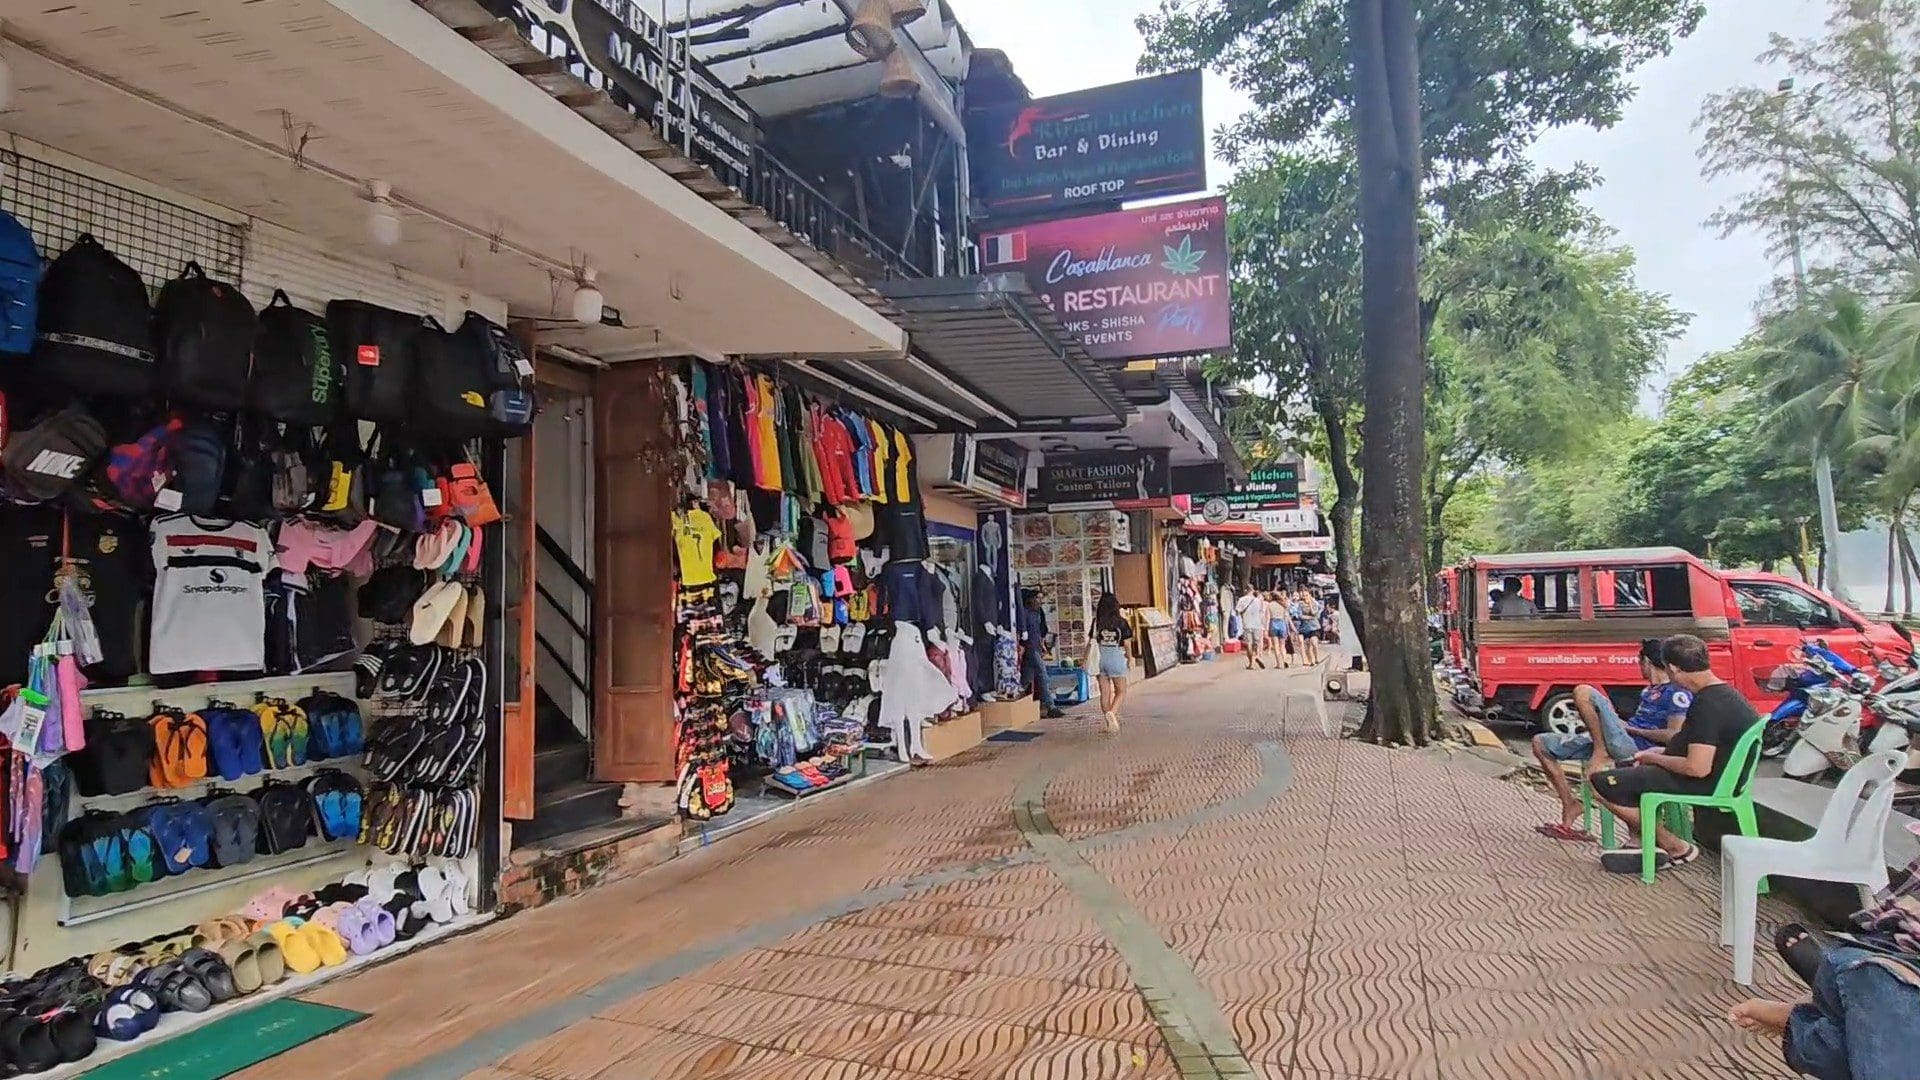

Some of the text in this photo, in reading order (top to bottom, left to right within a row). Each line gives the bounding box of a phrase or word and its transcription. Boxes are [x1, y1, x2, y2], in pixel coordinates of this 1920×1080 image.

[608, 31, 701, 121] MARLIN
[1035, 130, 1159, 160] Bar & Dining
[1064, 179, 1125, 199] ROOF TOP
[1046, 245, 1154, 284] Casablanca
[1064, 275, 1220, 313] RESTAURANT
[1101, 315, 1146, 330] SHISHA
[1085, 331, 1133, 345] EVENTS
[309, 322, 332, 404] Superdry
[26, 449, 86, 480] NIKE
[1051, 467, 1083, 480] SMART
[1087, 464, 1136, 478] FASHION
[1250, 469, 1294, 481] kitchen
[1055, 479, 1131, 492] Custom Tailors
